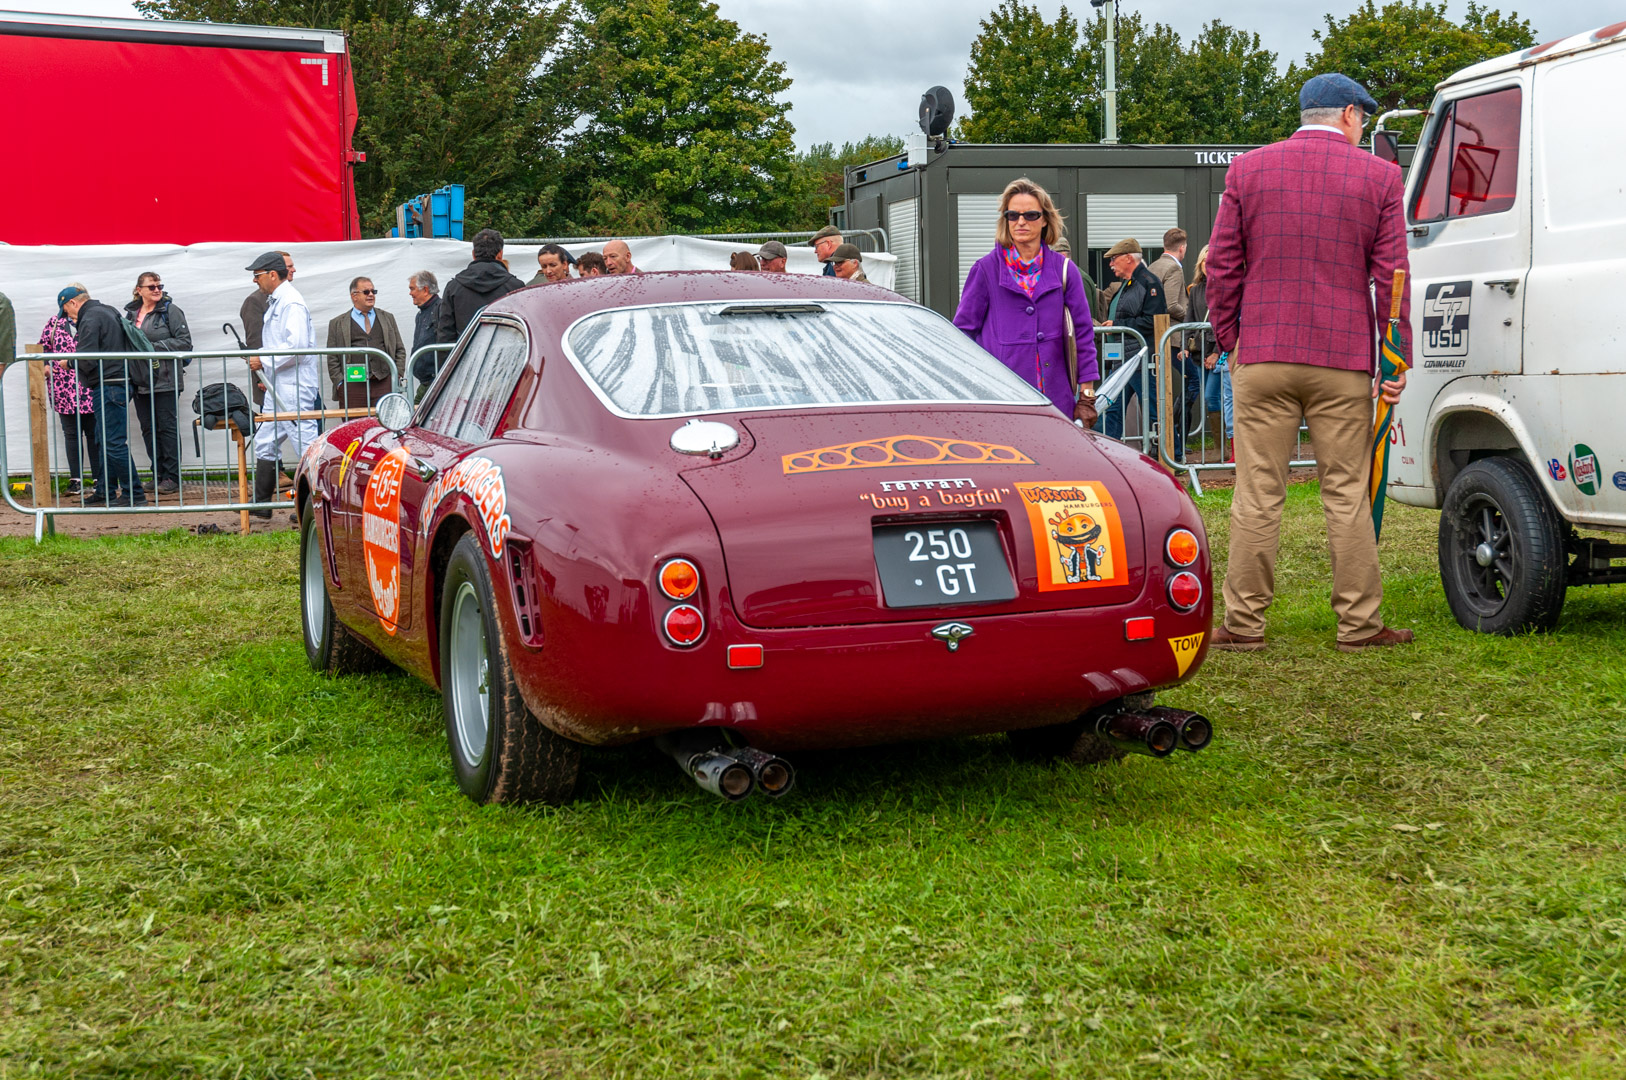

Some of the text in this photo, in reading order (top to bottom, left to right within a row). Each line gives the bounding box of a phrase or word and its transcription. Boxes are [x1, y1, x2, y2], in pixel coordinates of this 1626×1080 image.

[1429, 329, 1462, 348] USD
[1546, 458, 1560, 481] VP
[1573, 456, 1595, 483] Castrol
[879, 478, 977, 492] Ferrari
[1021, 486, 1087, 503] Wetson's
[421, 456, 513, 560] HAMBURGERS
[919, 495, 932, 507] a
[1063, 502, 1113, 510] HAMBURGERS
[363, 511, 398, 554] HAMBURGERS
[904, 528, 972, 562] 250
[936, 563, 977, 596] GT
[1173, 635, 1201, 652] TOW
